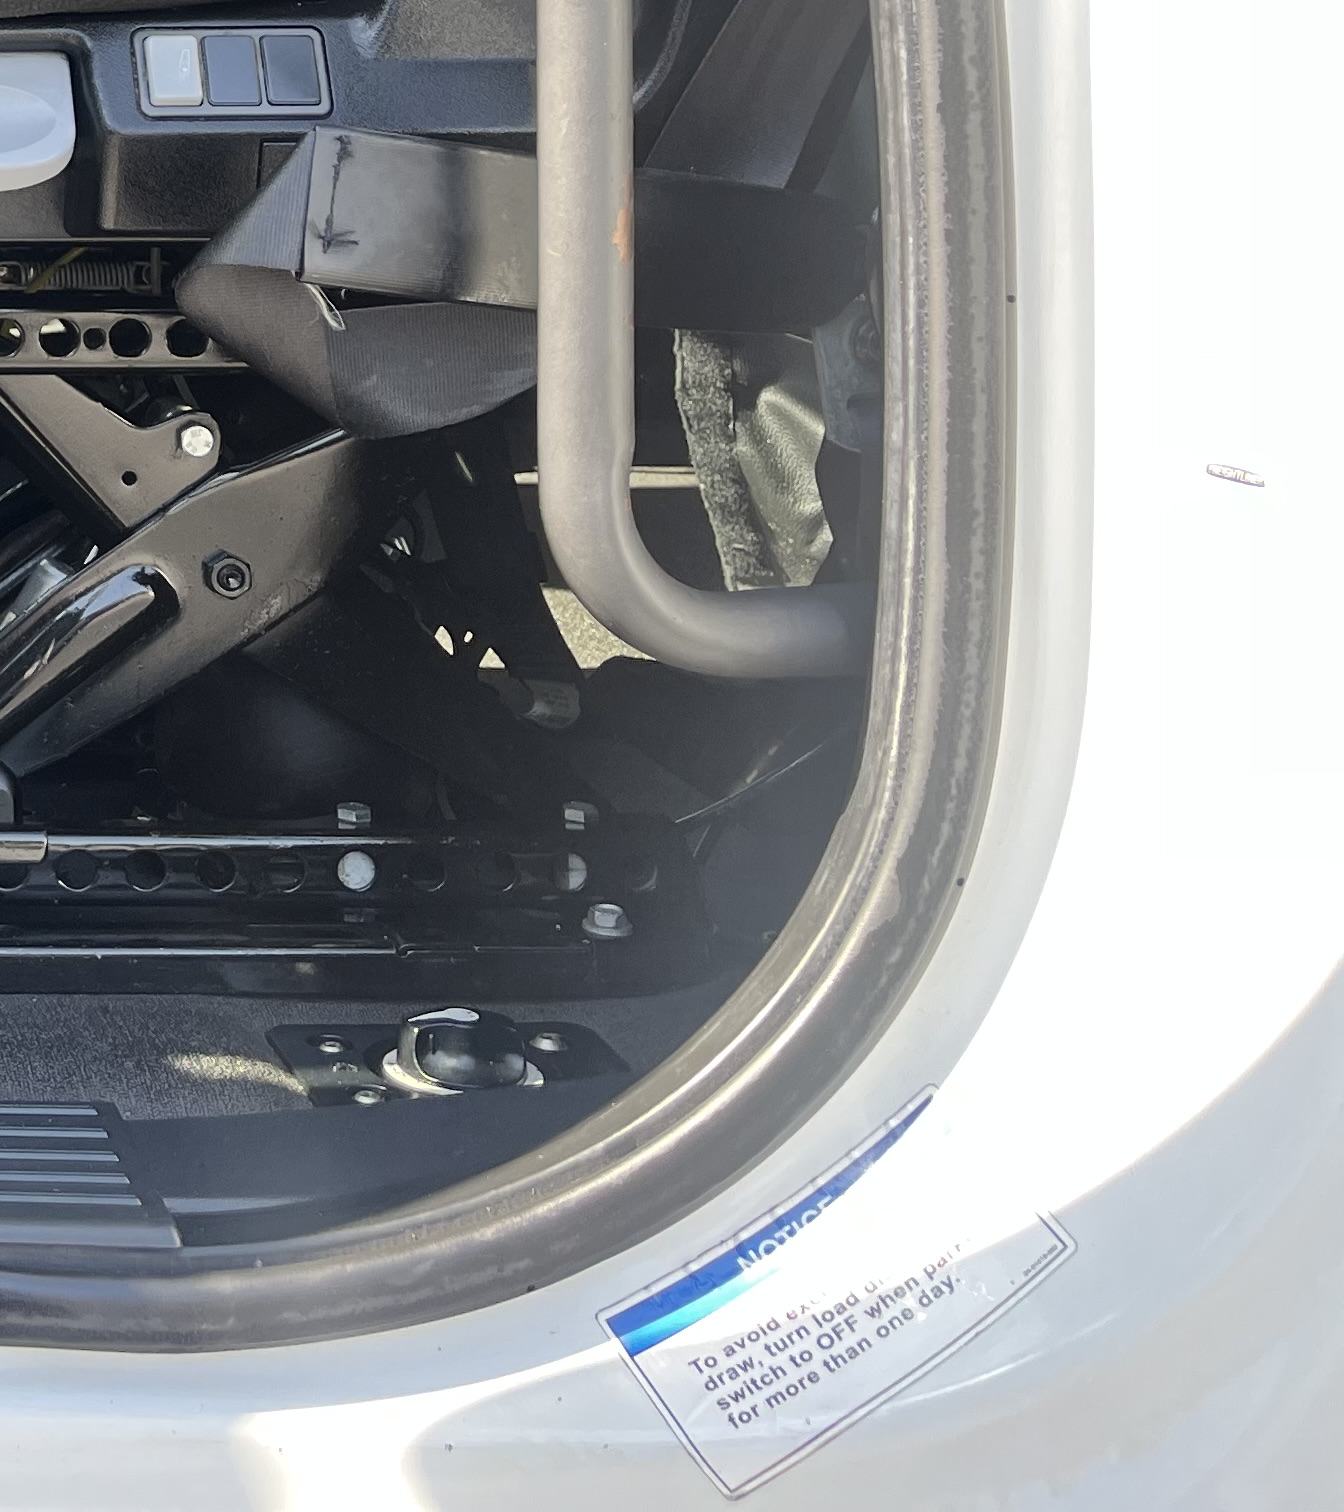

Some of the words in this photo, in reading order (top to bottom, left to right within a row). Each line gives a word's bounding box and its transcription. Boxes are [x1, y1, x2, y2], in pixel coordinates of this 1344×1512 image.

[687, 1354, 718, 1375] To
[723, 1316, 782, 1358] avoid
[704, 1356, 764, 1392] draw,
[764, 1324, 811, 1357] turn
[811, 1290, 861, 1329] load
[716, 1365, 788, 1411] switch
[789, 1349, 814, 1368] to
[816, 1313, 858, 1350] OFF
[863, 1276, 920, 1319] when
[727, 1403, 760, 1430] for
[765, 1370, 821, 1409] more
[823, 1336, 873, 1374] than
[876, 1307, 915, 1338] one
[918, 1274, 962, 1308] day.
